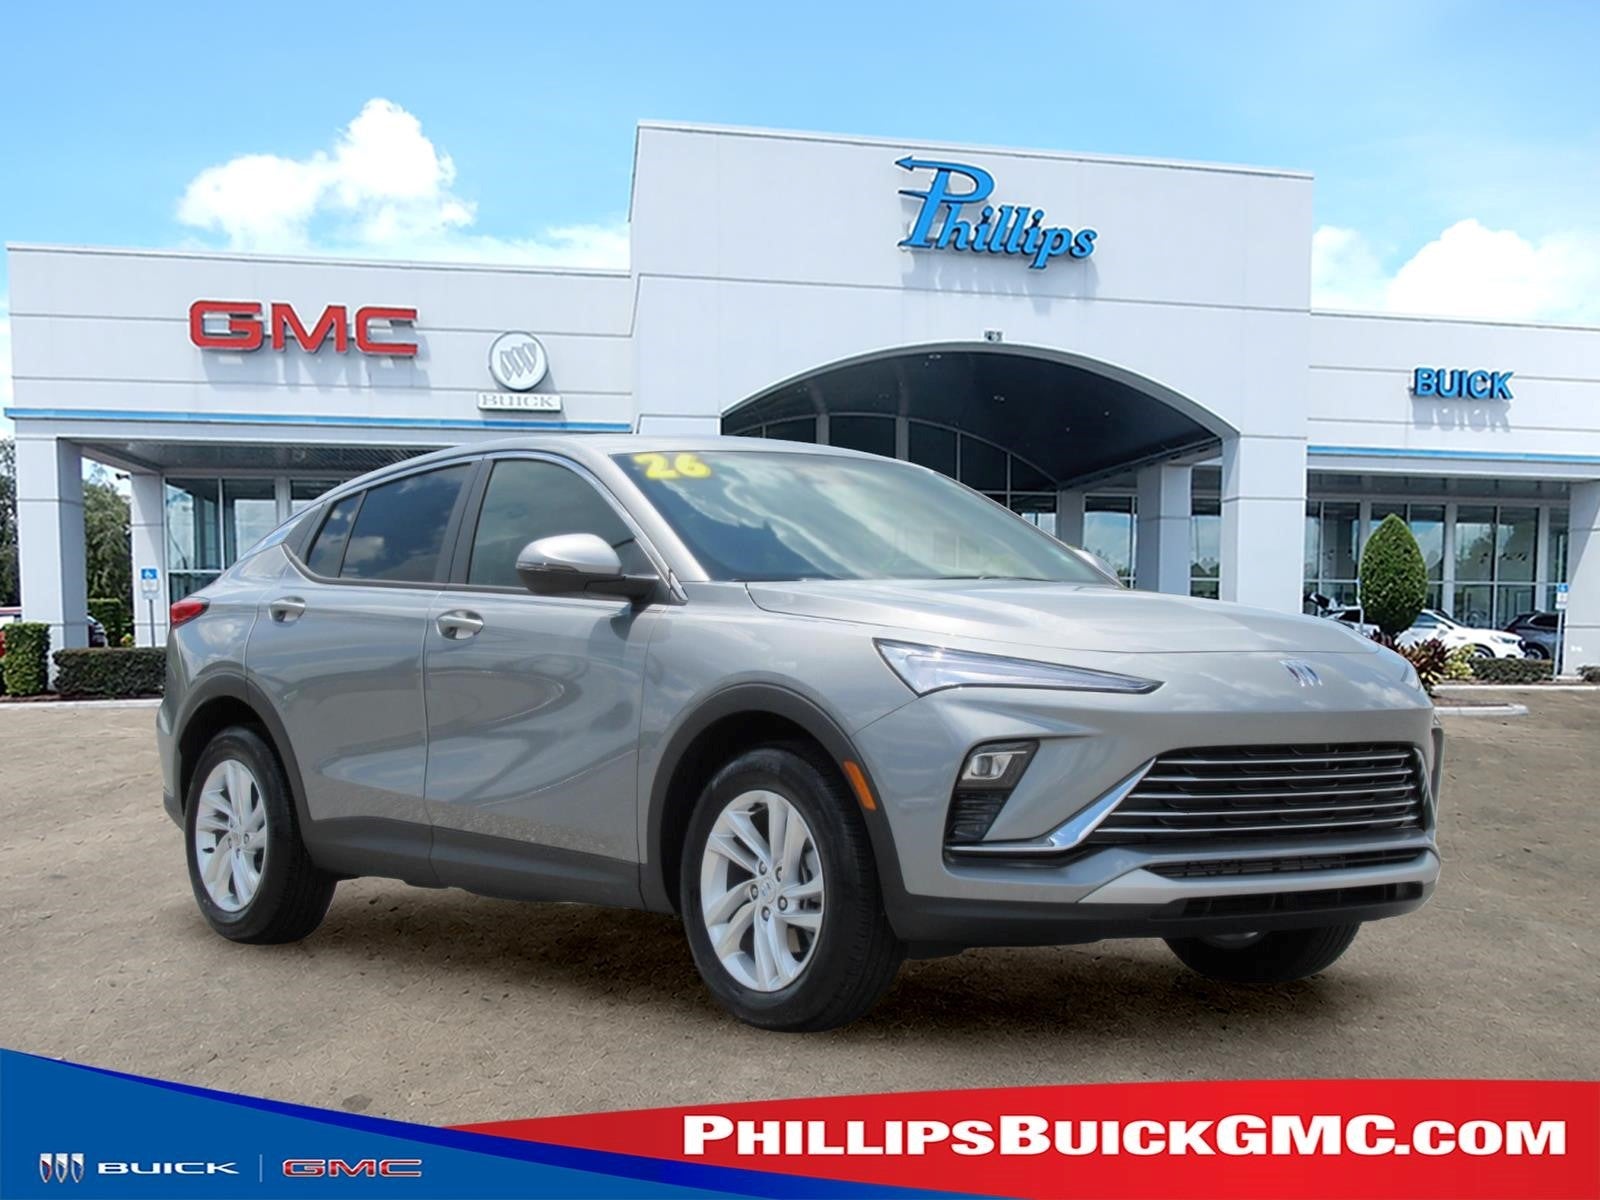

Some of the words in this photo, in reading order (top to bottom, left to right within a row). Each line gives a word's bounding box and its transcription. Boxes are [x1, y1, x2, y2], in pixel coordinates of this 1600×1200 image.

[895, 156, 1097, 270] Phillips
[190, 300, 418, 358] GMC
[1411, 367, 1513, 400] BUICK
[482, 394, 555, 407] BUICK
[632, 453, 712, 479] 26
